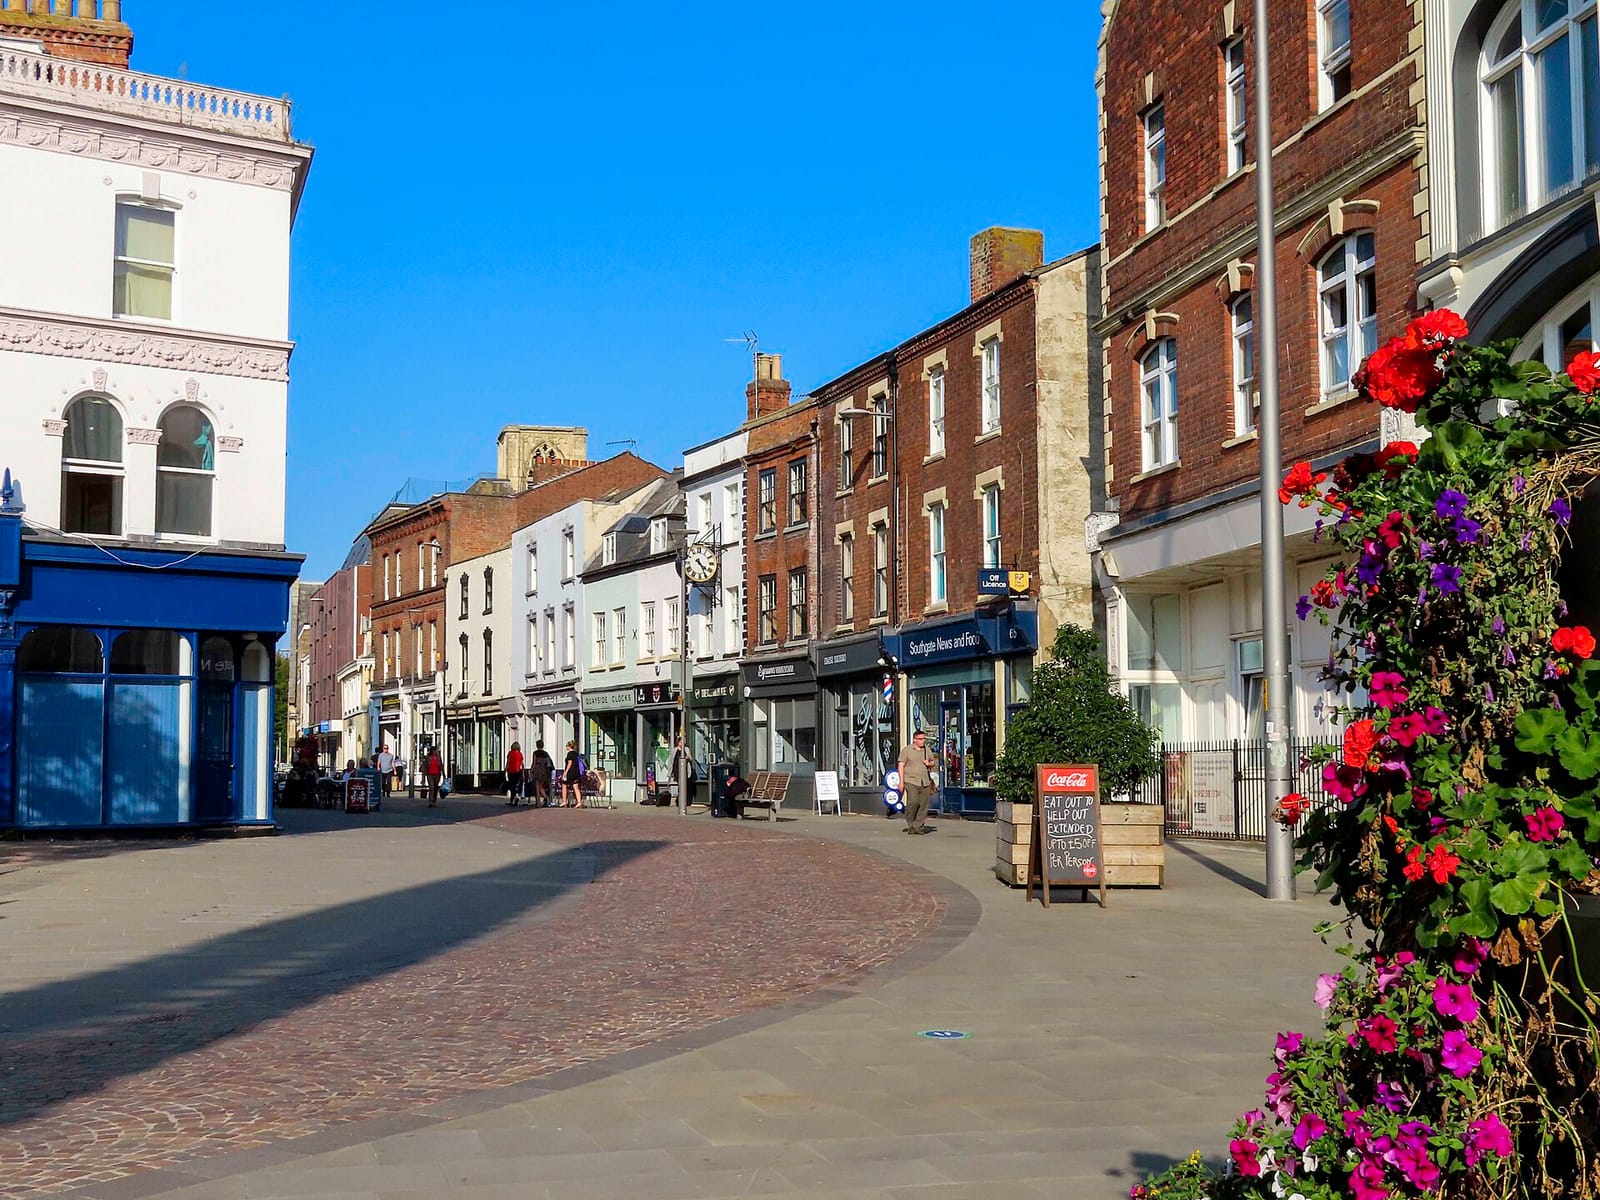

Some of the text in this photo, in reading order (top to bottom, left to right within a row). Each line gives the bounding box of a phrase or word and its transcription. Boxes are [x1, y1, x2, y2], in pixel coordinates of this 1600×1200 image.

[982, 580, 1006, 588] Licence
[989, 574, 999, 582] Off
[909, 640, 936, 657] Southgate
[936, 636, 953, 651] News
[953, 632, 965, 648] and
[611, 694, 632, 703] CLOCKS
[1047, 773, 1088, 787] Coca-Cola
[1044, 796, 1094, 808] EAT OUT TO
[1047, 808, 1089, 822] HELP OUT
[1047, 823, 1094, 835] EXTENDED
